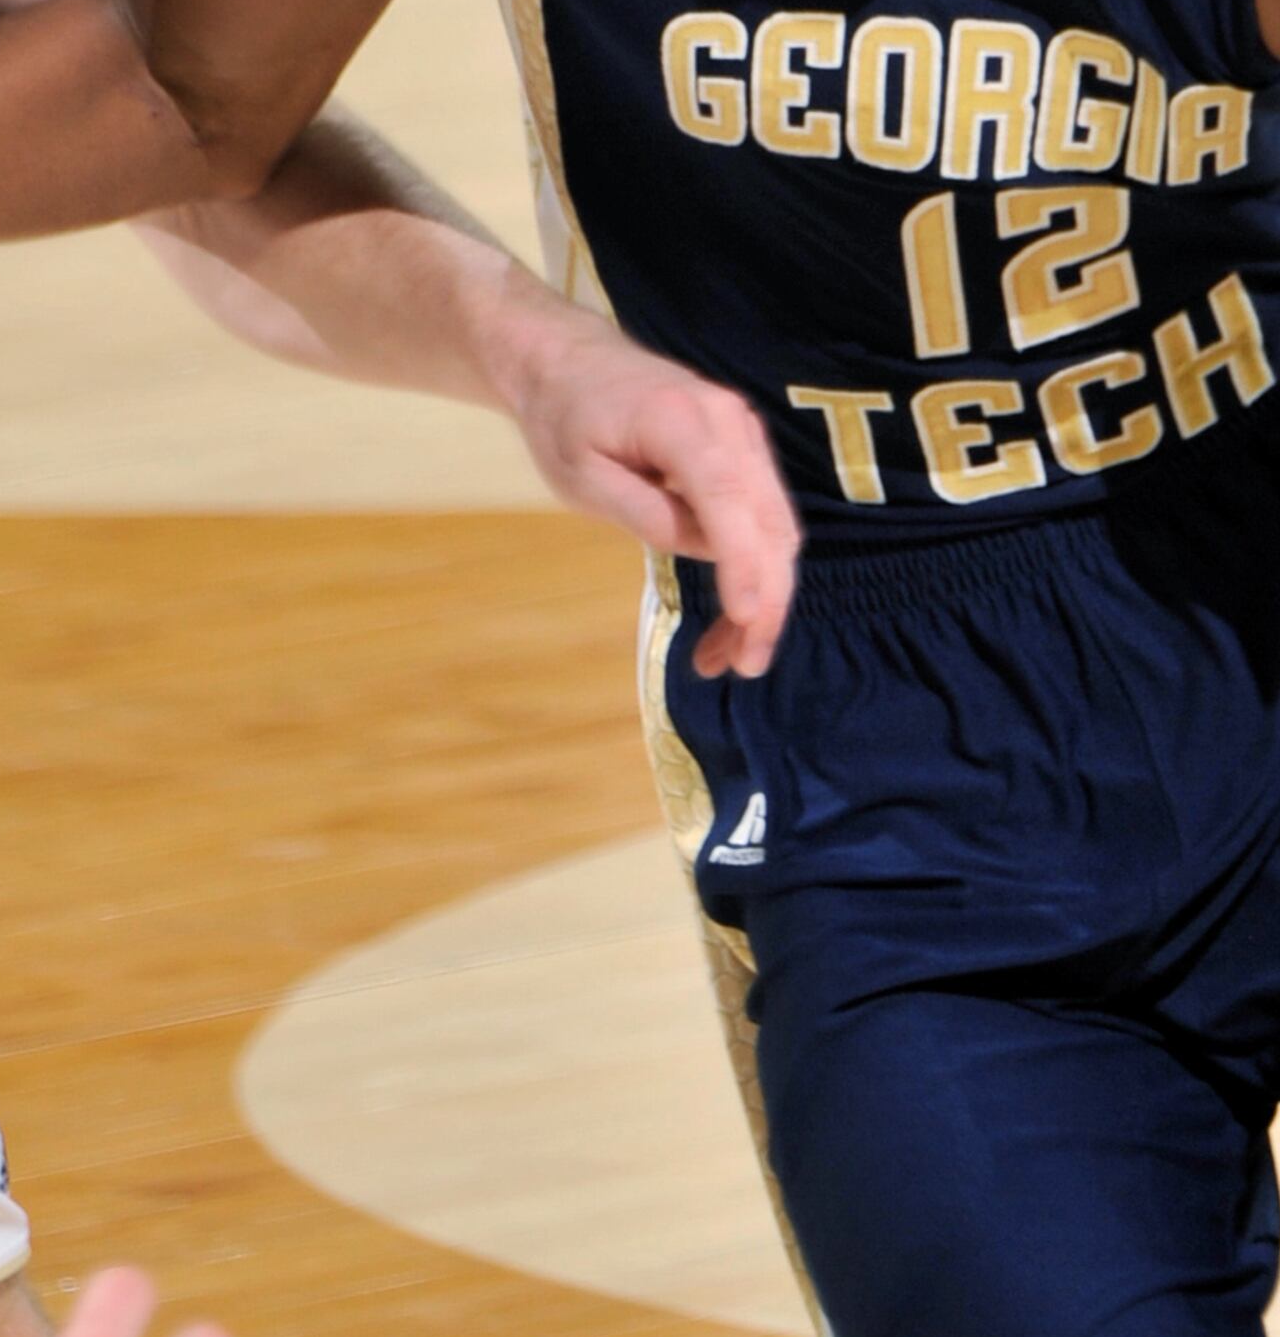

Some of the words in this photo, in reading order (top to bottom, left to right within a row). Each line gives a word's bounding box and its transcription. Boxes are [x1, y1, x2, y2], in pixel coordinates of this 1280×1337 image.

[661, 11, 1254, 186] GEORGIA
[901, 185, 1141, 360] 12
[785, 273, 1277, 505] TECH
